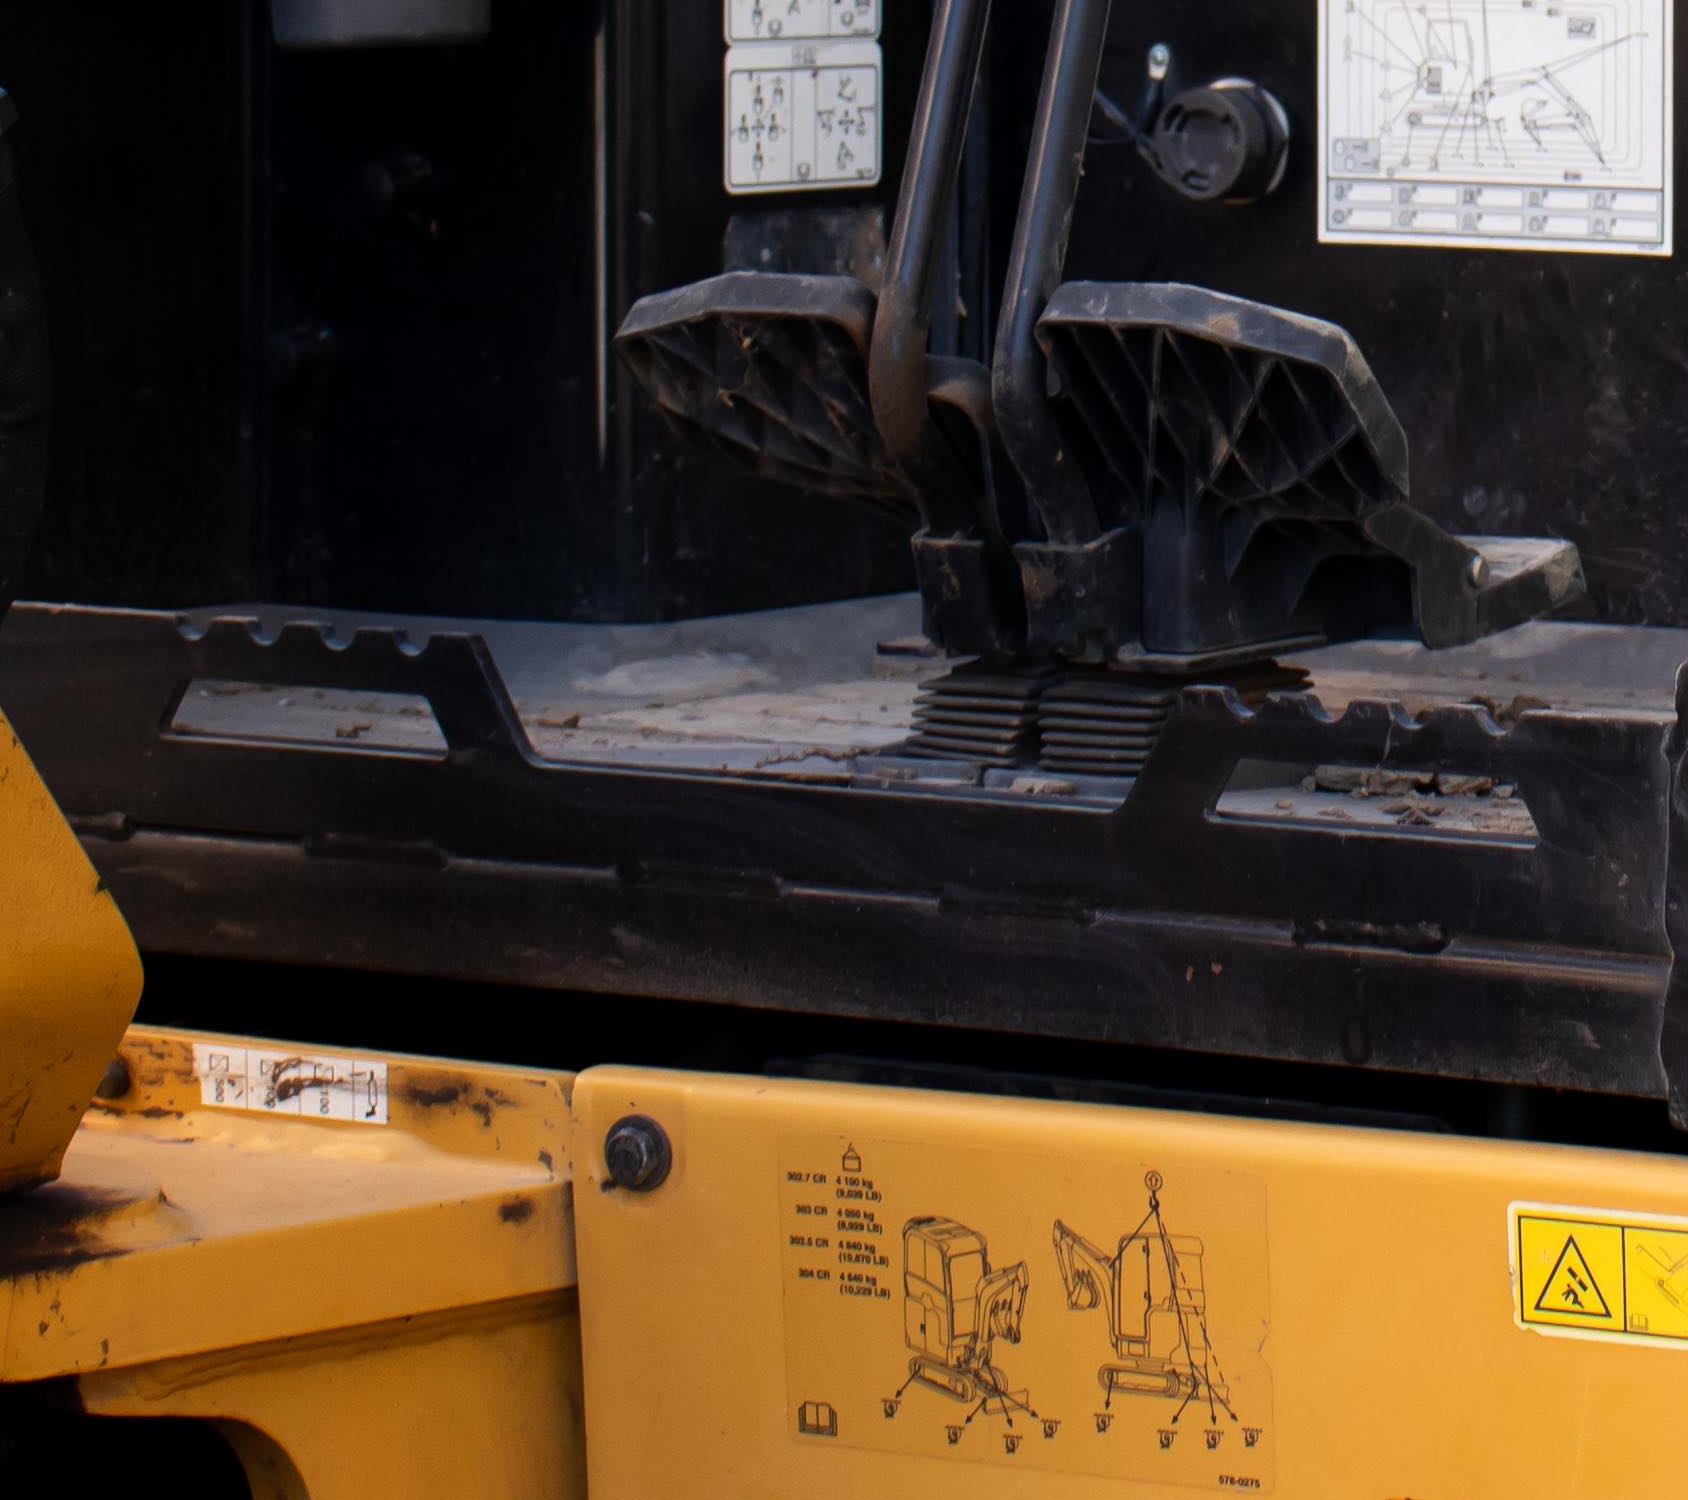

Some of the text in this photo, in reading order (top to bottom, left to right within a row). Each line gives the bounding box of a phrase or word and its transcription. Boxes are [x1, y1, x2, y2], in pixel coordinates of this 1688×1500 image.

[861, 1178, 874, 1190] kg
[863, 1210, 875, 1222] kg
[864, 1242, 876, 1255] kg
[865, 1274, 877, 1287] kg
